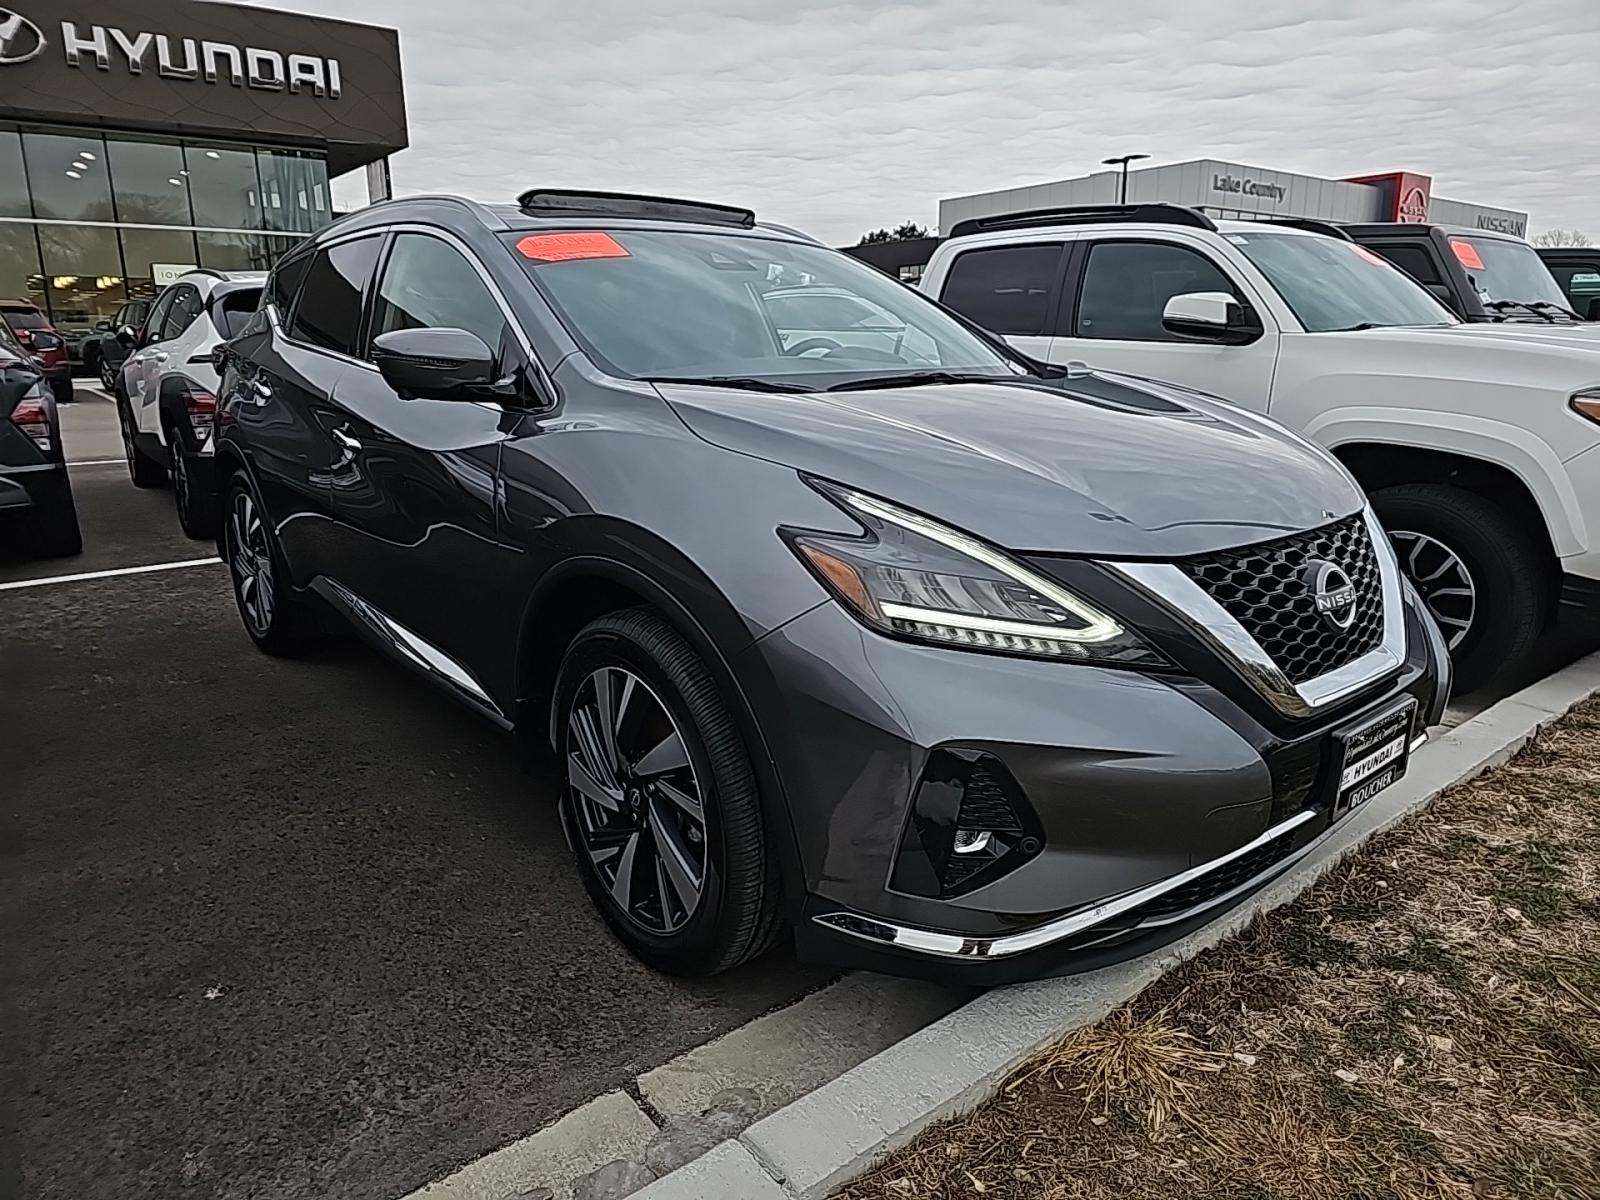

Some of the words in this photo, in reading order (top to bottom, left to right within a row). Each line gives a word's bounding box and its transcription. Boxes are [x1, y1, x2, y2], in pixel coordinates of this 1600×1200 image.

[60, 21, 341, 98] HYUNDAI
[1213, 174, 1240, 193] Lake
[1242, 179, 1286, 204] Country
[1477, 214, 1524, 237] NISSAN
[160, 271, 181, 279] ION
[1317, 590, 1355, 610] NISS
[1354, 746, 1393, 779] HYUNDAI
[1351, 771, 1392, 808] BOUCHER
